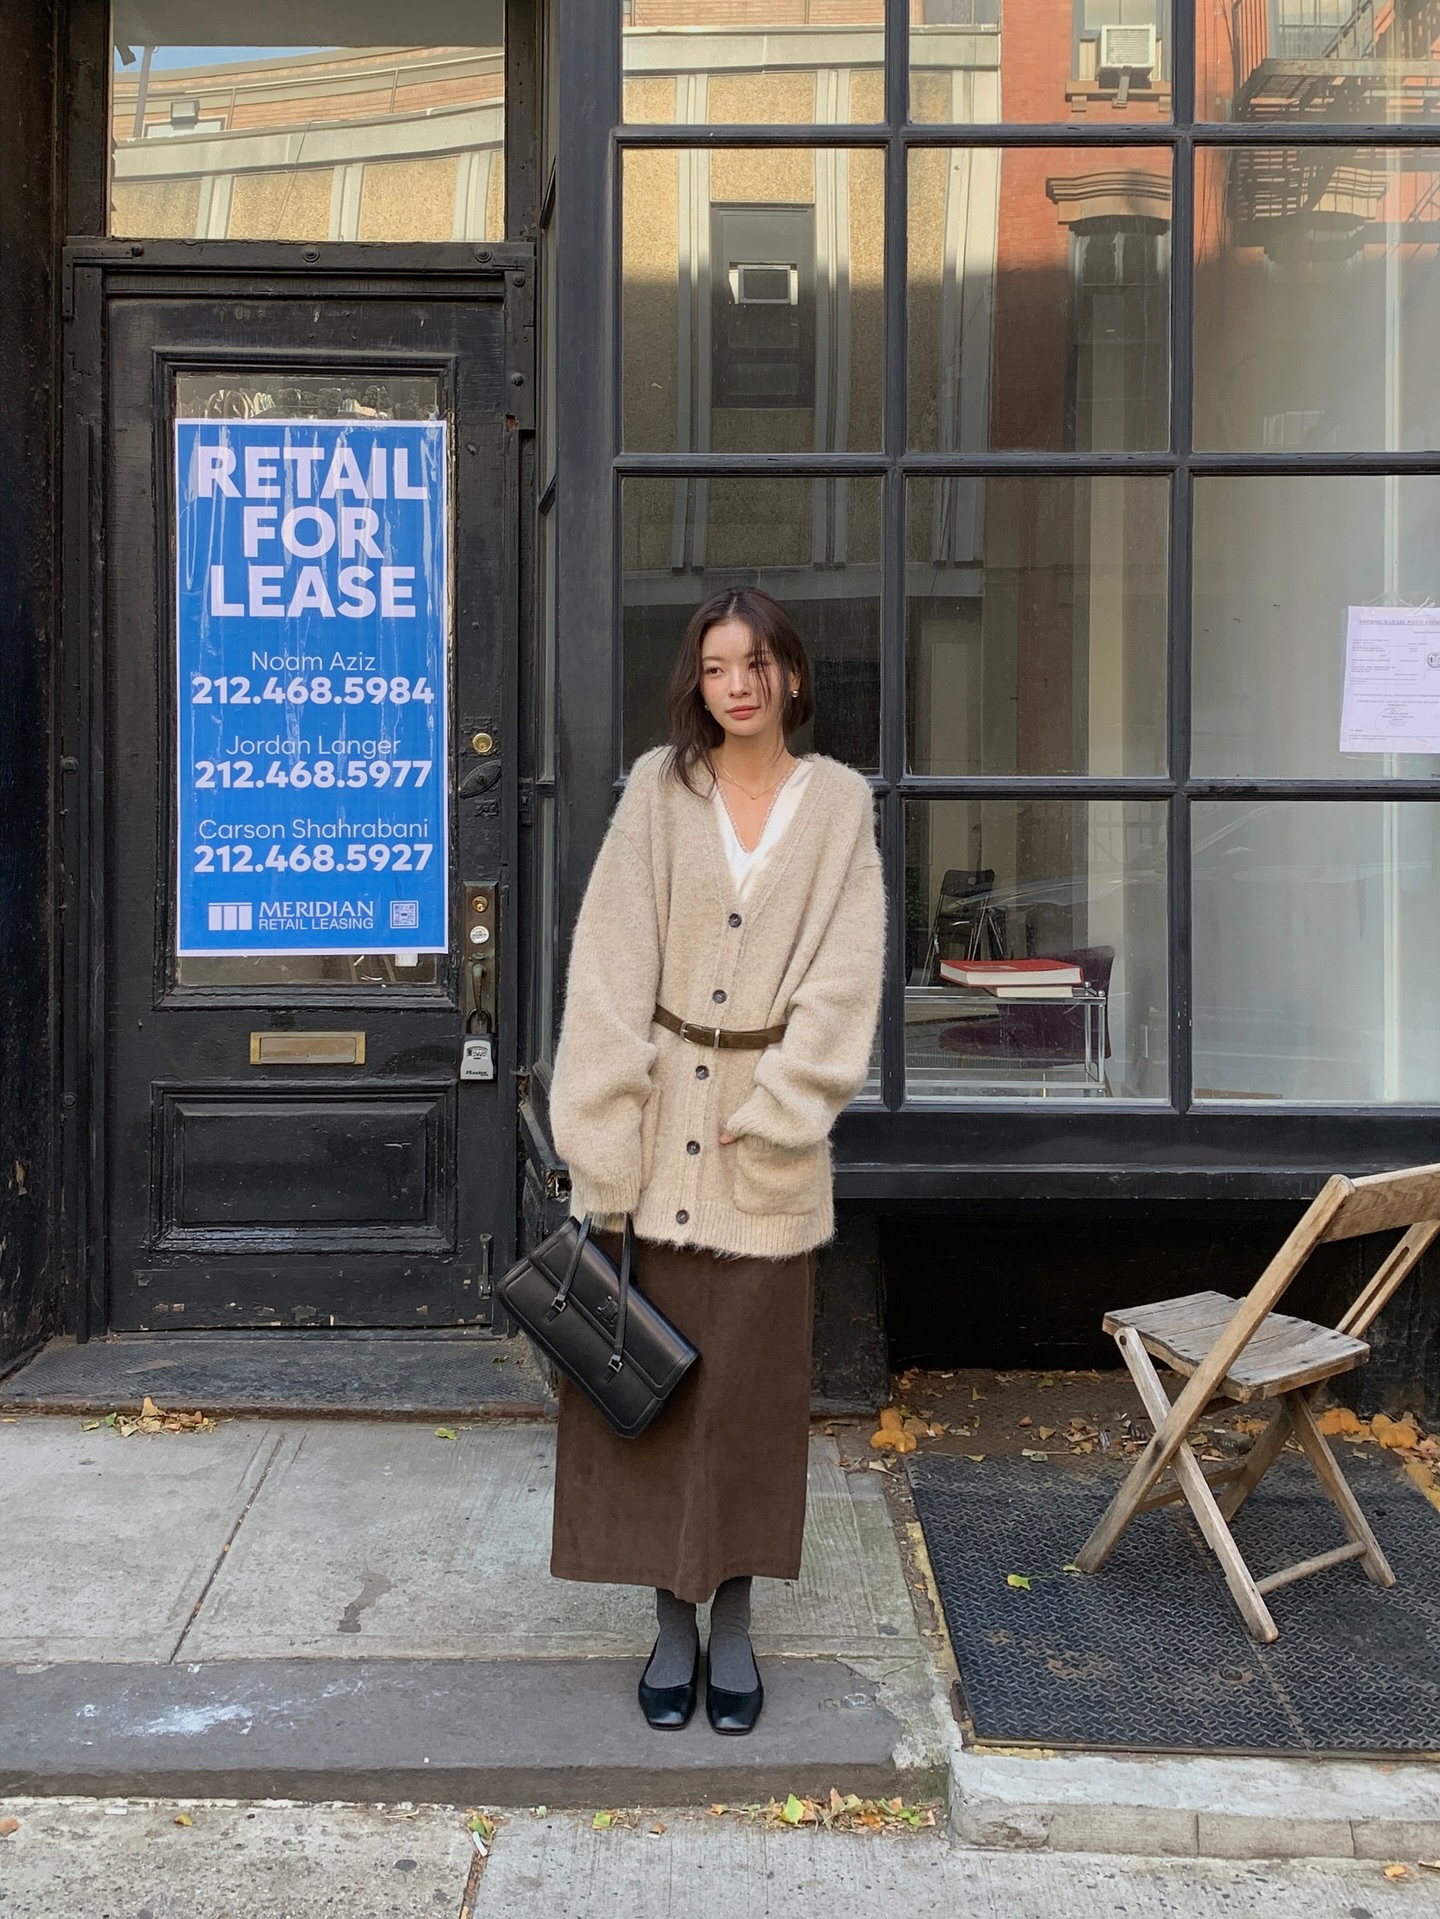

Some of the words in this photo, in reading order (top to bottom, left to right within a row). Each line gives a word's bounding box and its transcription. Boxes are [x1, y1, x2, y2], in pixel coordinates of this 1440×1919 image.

[198, 446, 428, 500] RETAIL
[243, 506, 385, 559] FOR
[210, 565, 416, 618] LEASE
[252, 651, 323, 671] Noam
[329, 651, 376, 671] Aziz
[191, 676, 435, 705] 212.468.5984
[226, 735, 311, 756] Jordan
[318, 735, 401, 759] Langer
[194, 760, 433, 789] 212.468.5977
[199, 819, 285, 839] Carson
[292, 819, 428, 838] Shahrabani
[194, 843, 434, 873] 212.468.5927
[259, 901, 374, 918] MERIDIAN
[259, 918, 308, 931] RETAIL
[312, 917, 374, 930] LEASING
